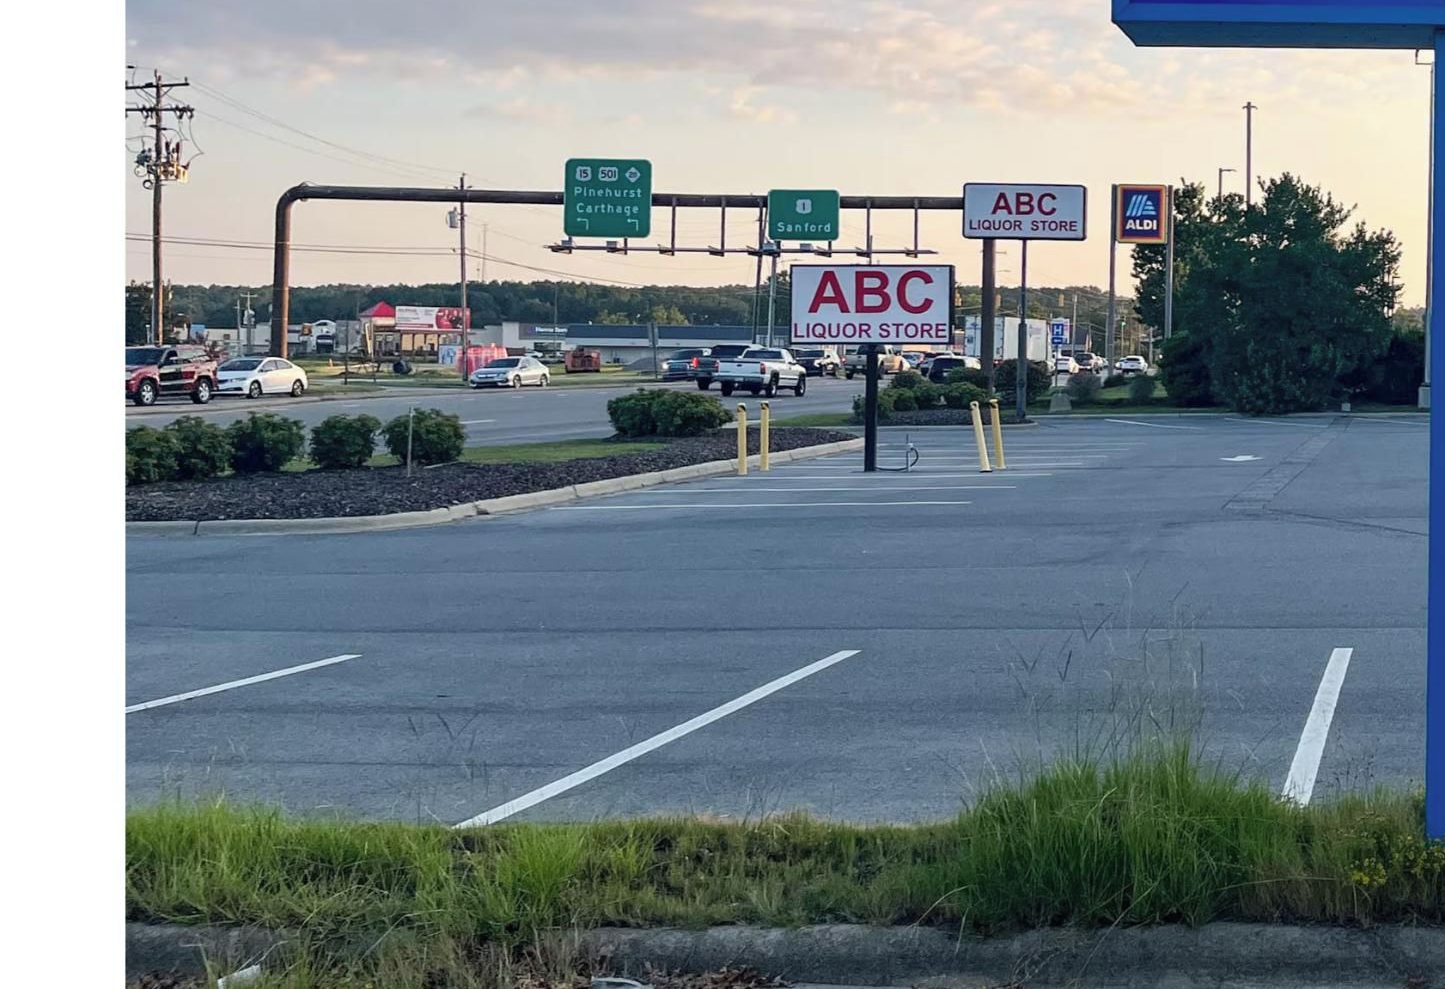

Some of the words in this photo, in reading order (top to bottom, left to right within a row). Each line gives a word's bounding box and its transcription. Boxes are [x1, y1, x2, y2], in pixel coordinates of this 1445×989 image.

[579, 169, 589, 179] 15
[600, 169, 617, 179] 501
[574, 186, 642, 198] Pinehurst
[576, 202, 639, 217] Carthage
[991, 192, 1057, 216] ABC
[777, 221, 831, 232] Sanford
[969, 219, 1023, 231] LIQUOR
[1031, 219, 1078, 232] STORE
[1126, 219, 1157, 231] ALDI
[808, 270, 934, 314] ABC
[793, 322, 872, 339] LIQUOR
[879, 322, 947, 338] STORE
[1053, 325, 1063, 336] H
